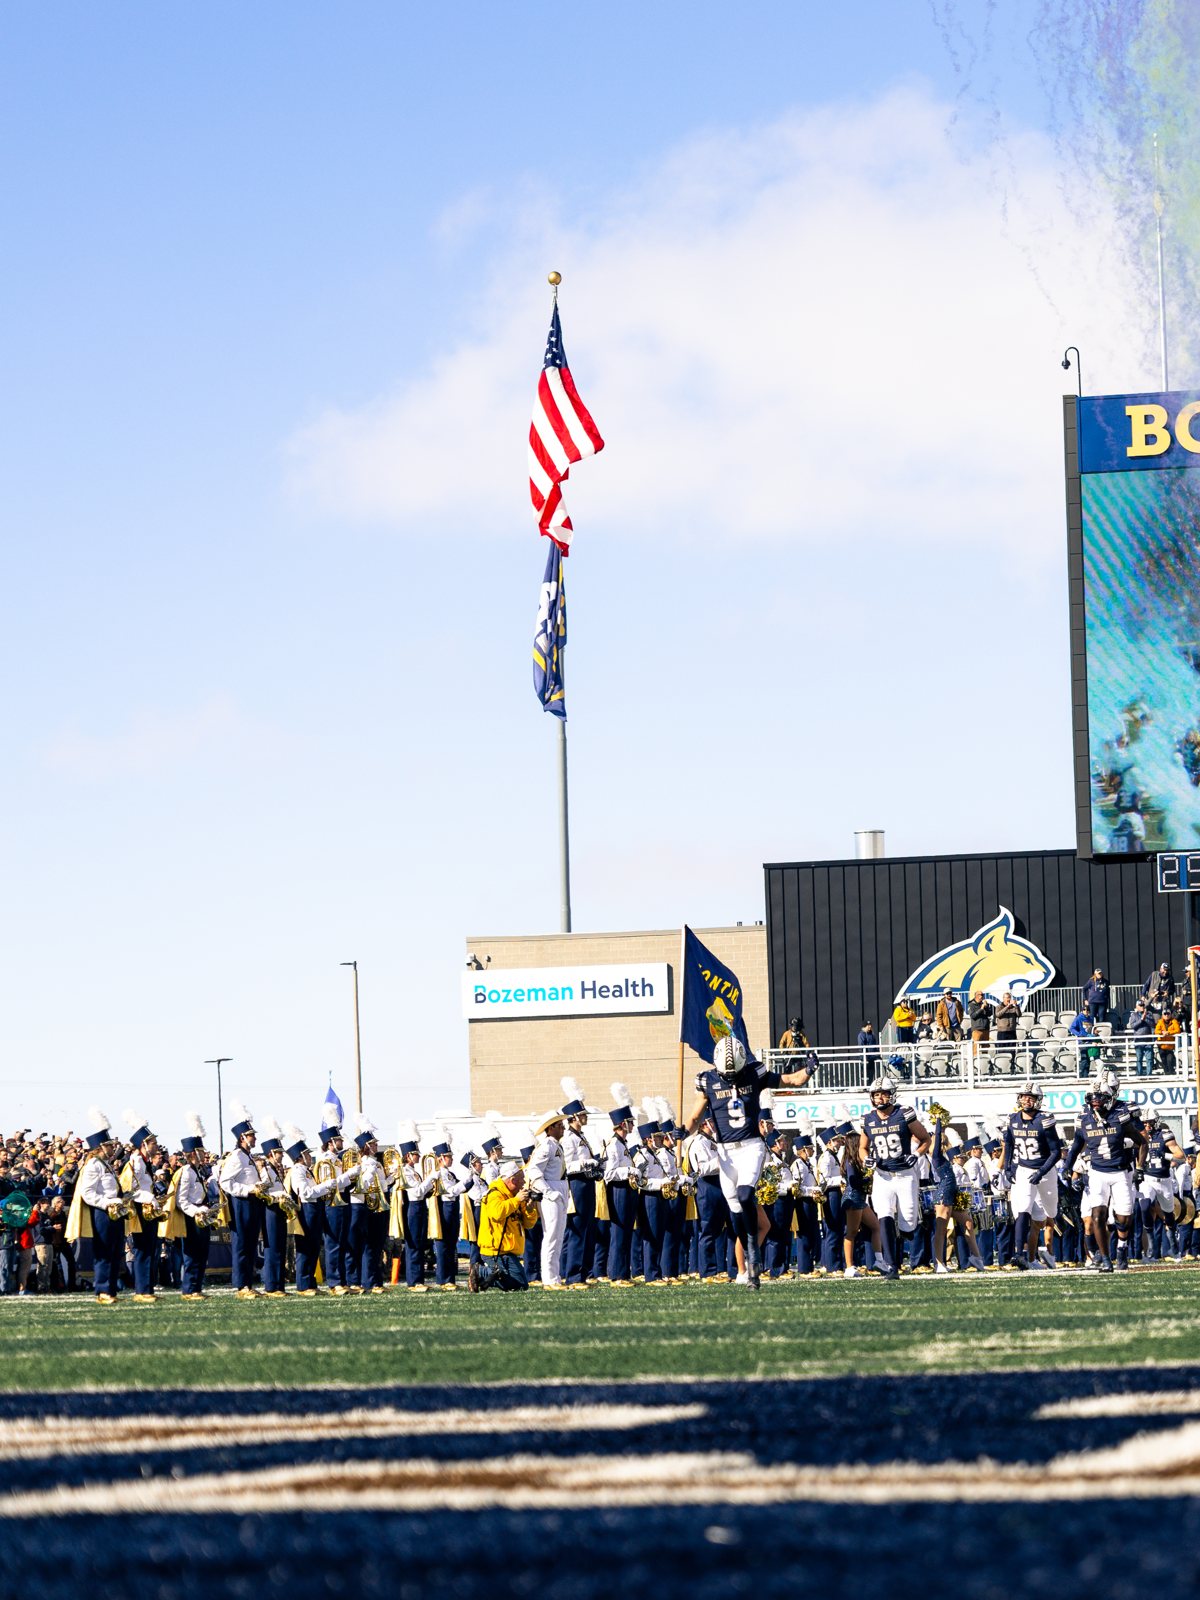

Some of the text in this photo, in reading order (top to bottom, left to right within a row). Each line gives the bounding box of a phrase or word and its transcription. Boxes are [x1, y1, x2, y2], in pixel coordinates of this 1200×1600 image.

[474, 977, 655, 1004] Bozeman Health
[873, 1134, 902, 1161] 89
[1014, 1137, 1042, 1161] 32
[1097, 1136, 1112, 1160] 4
